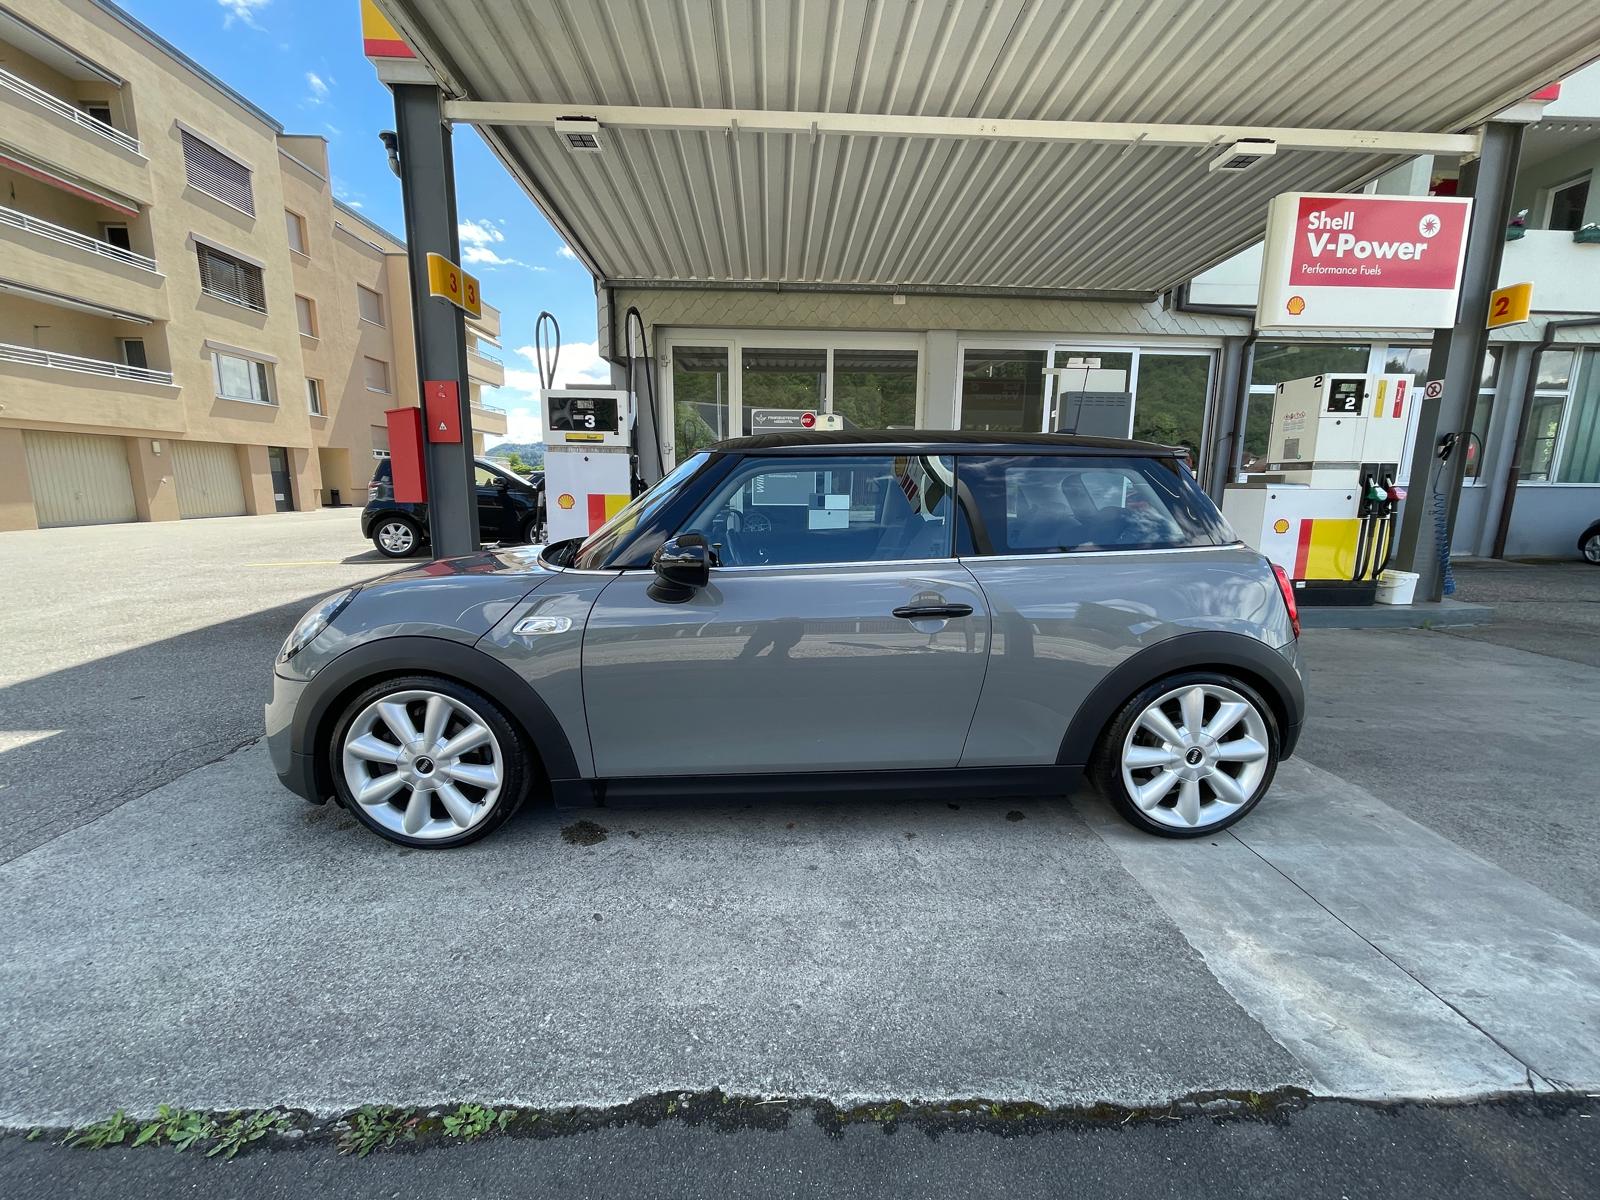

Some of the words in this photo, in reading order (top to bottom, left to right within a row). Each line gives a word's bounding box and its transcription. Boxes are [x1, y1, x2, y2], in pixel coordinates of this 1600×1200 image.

[1307, 211, 1355, 231] Shell
[1307, 232, 1428, 260] V-Power
[1301, 263, 1358, 275] Performance
[1360, 264, 1382, 276] Fuels
[449, 272, 458, 294] 3
[467, 284, 475, 305] 3
[1494, 296, 1510, 318] 2
[1278, 383, 1284, 394] 1
[1313, 375, 1323, 388] 2
[1344, 396, 1356, 410] 2
[584, 414, 596, 428] 3
